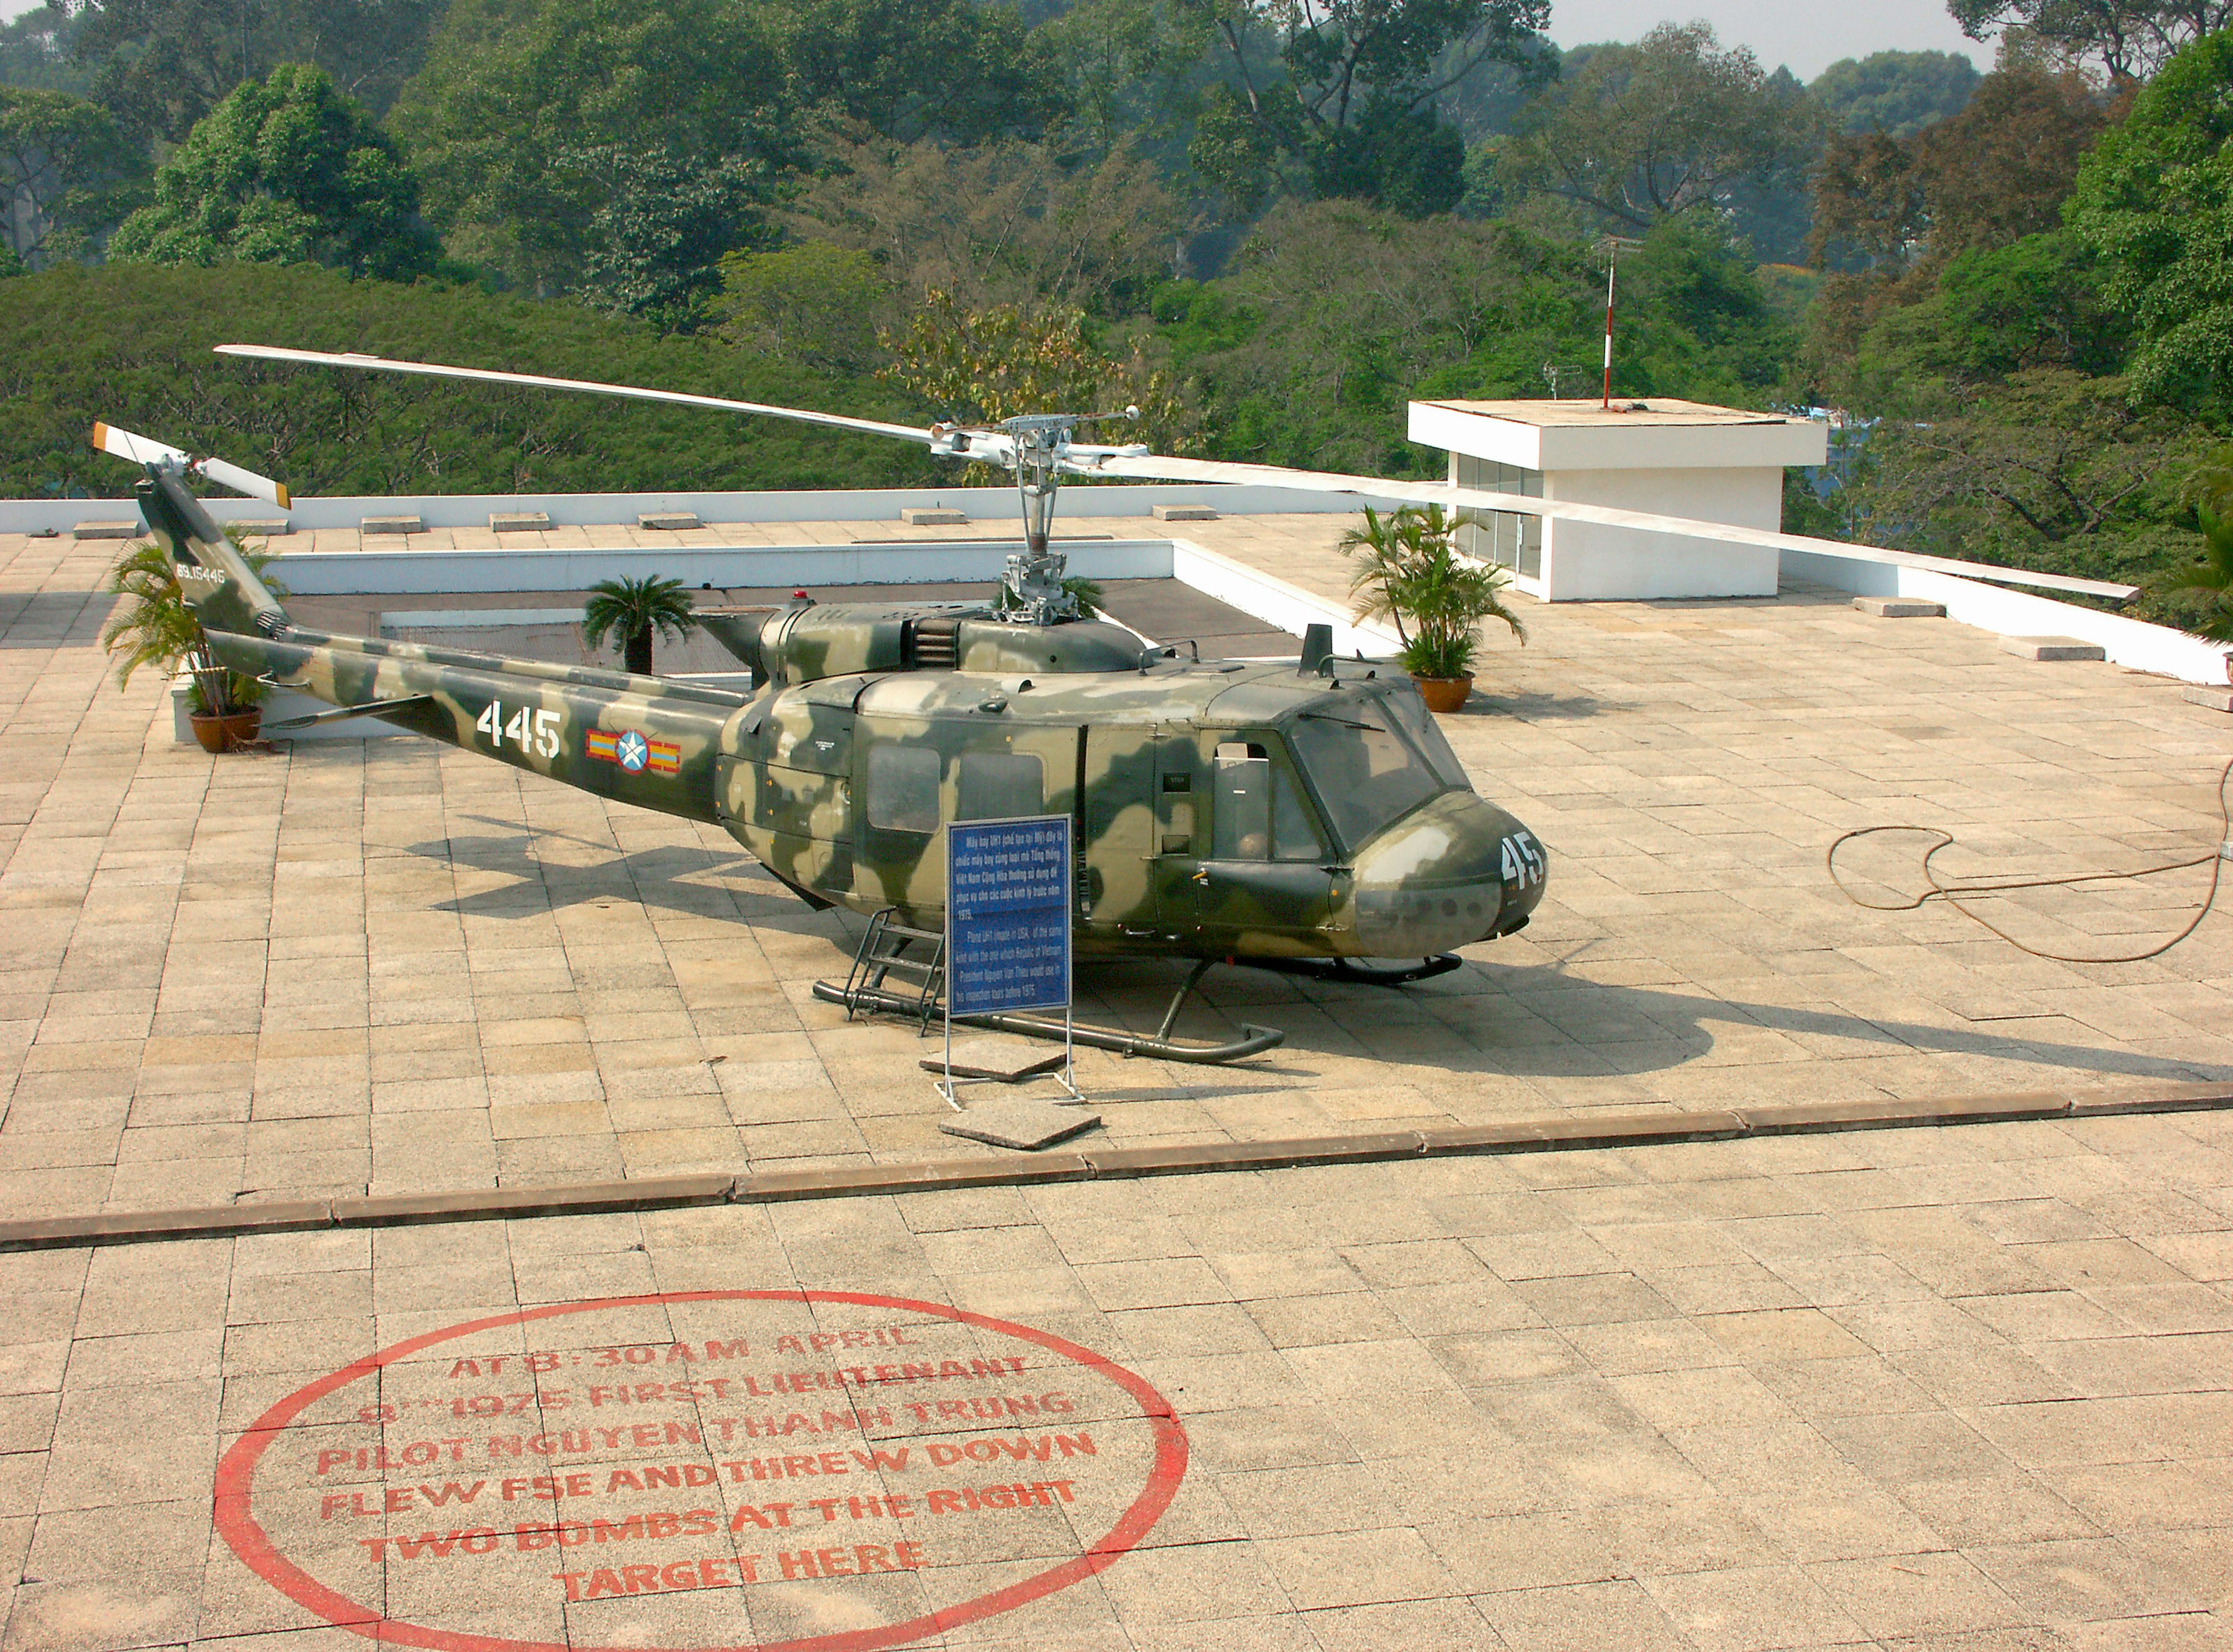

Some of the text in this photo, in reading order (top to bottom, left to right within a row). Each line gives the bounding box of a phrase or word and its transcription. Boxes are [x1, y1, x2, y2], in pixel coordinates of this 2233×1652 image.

[477, 700, 561, 758] 445
[450, 1358, 510, 1378] AT
[776, 1328, 917, 1354] APRIL
[451, 1389, 569, 1419] 1975
[590, 1379, 732, 1407] FIRST
[744, 1357, 1025, 1396] LIEUTENANT
[317, 1392, 1073, 1475] PILOT NGUYEN THANH TRUNG
[321, 1480, 485, 1518] FLEW
[607, 1465, 716, 1493] AND
[722, 1447, 909, 1483] THREW
[925, 1433, 1097, 1466] DOWN
[361, 1480, 1075, 1562] TWO BOMBS AT THE RIGHT
[553, 1542, 928, 1601] TARGET HERE
